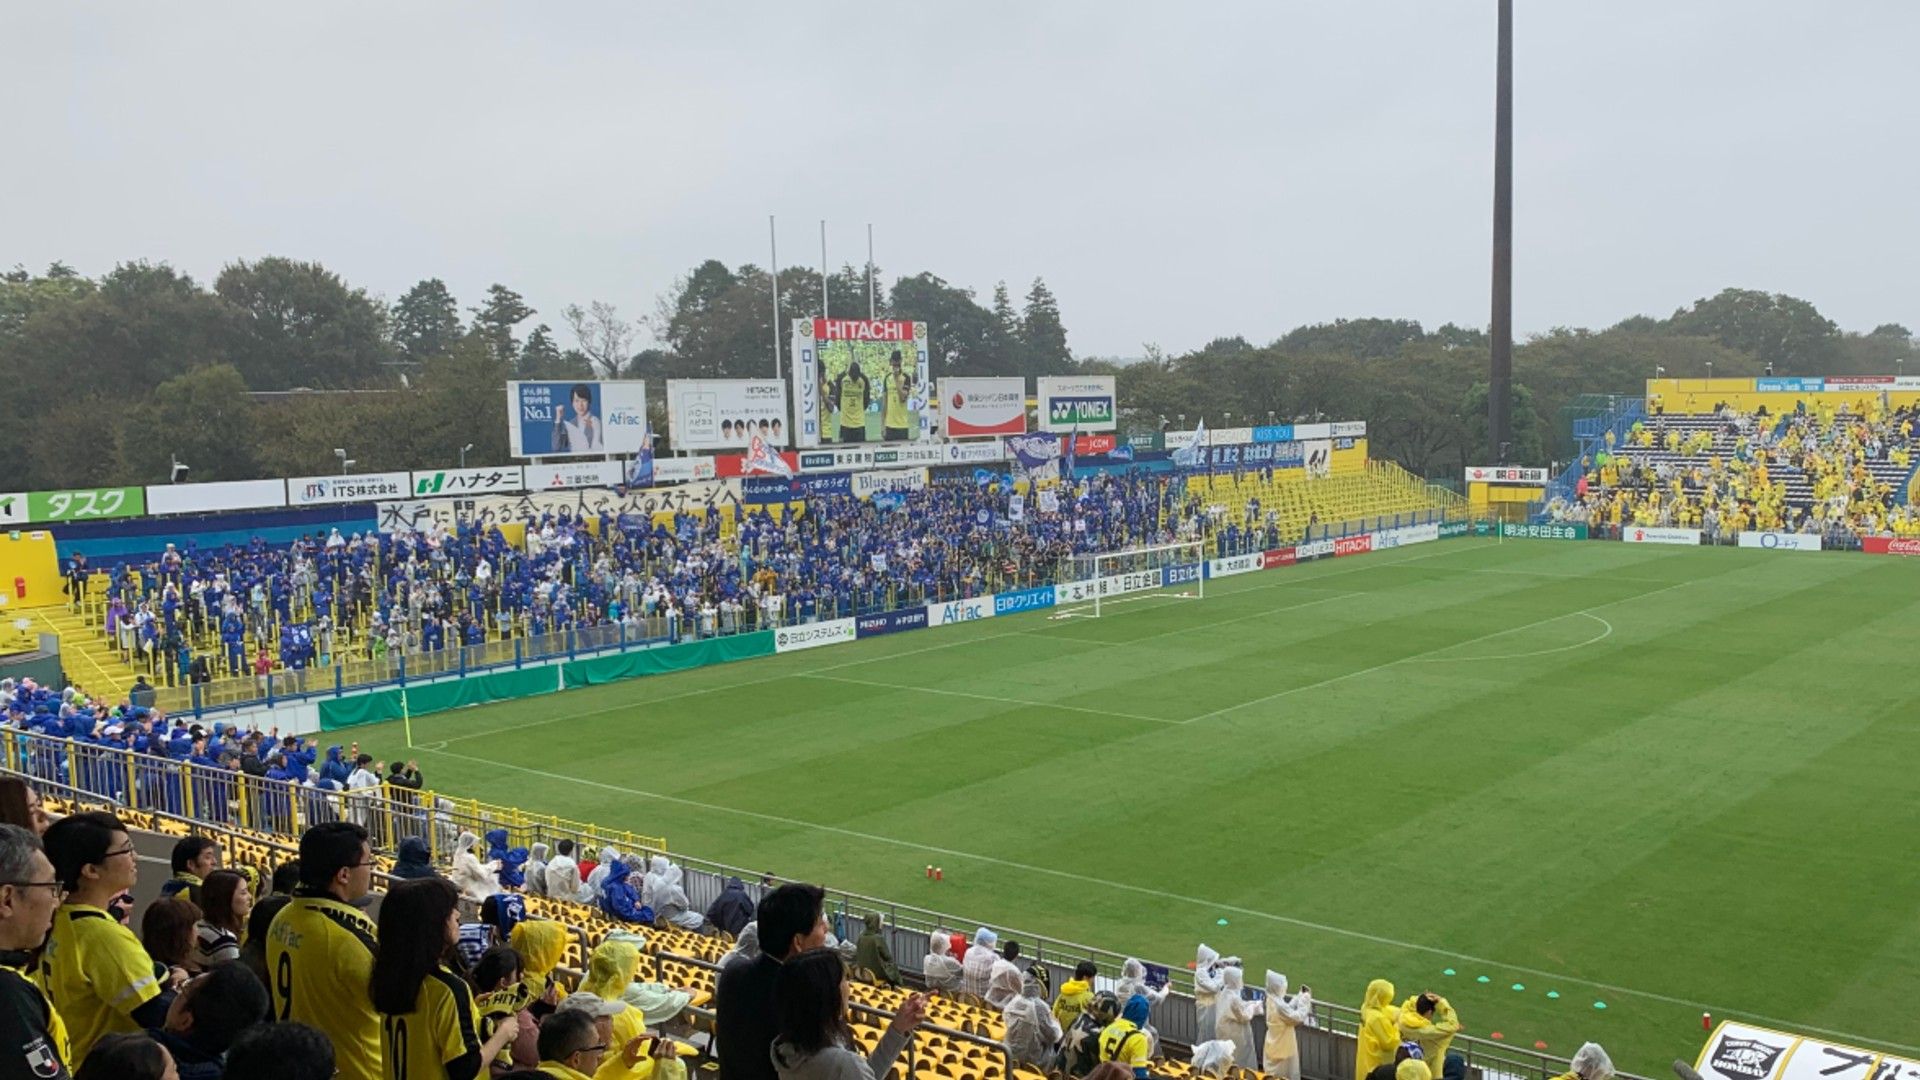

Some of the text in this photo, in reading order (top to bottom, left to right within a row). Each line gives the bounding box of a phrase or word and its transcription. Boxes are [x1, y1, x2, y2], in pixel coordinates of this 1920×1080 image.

[826, 321, 903, 339] HITACHI
[802, 349, 814, 413] ローソン
[523, 406, 552, 419] No.1
[1074, 401, 1110, 418] YONEX
[608, 412, 640, 425] Aflac
[836, 453, 873, 464] 東京建物
[447, 471, 520, 489] ハナタニ
[859, 475, 890, 490] Blue
[891, 470, 922, 492] spirit
[1496, 469, 1542, 480] 朝日新聞
[306, 485, 325, 498] ITS
[332, 483, 398, 498] ITS株式会社
[47, 490, 125, 518] タスク
[1503, 524, 1576, 538] 明治安田生命
[1336, 538, 1370, 554] HITACHI
[942, 602, 982, 624] Aflac
[790, 626, 843, 643] 日立システムズ
[277, 951, 292, 1021] 9
